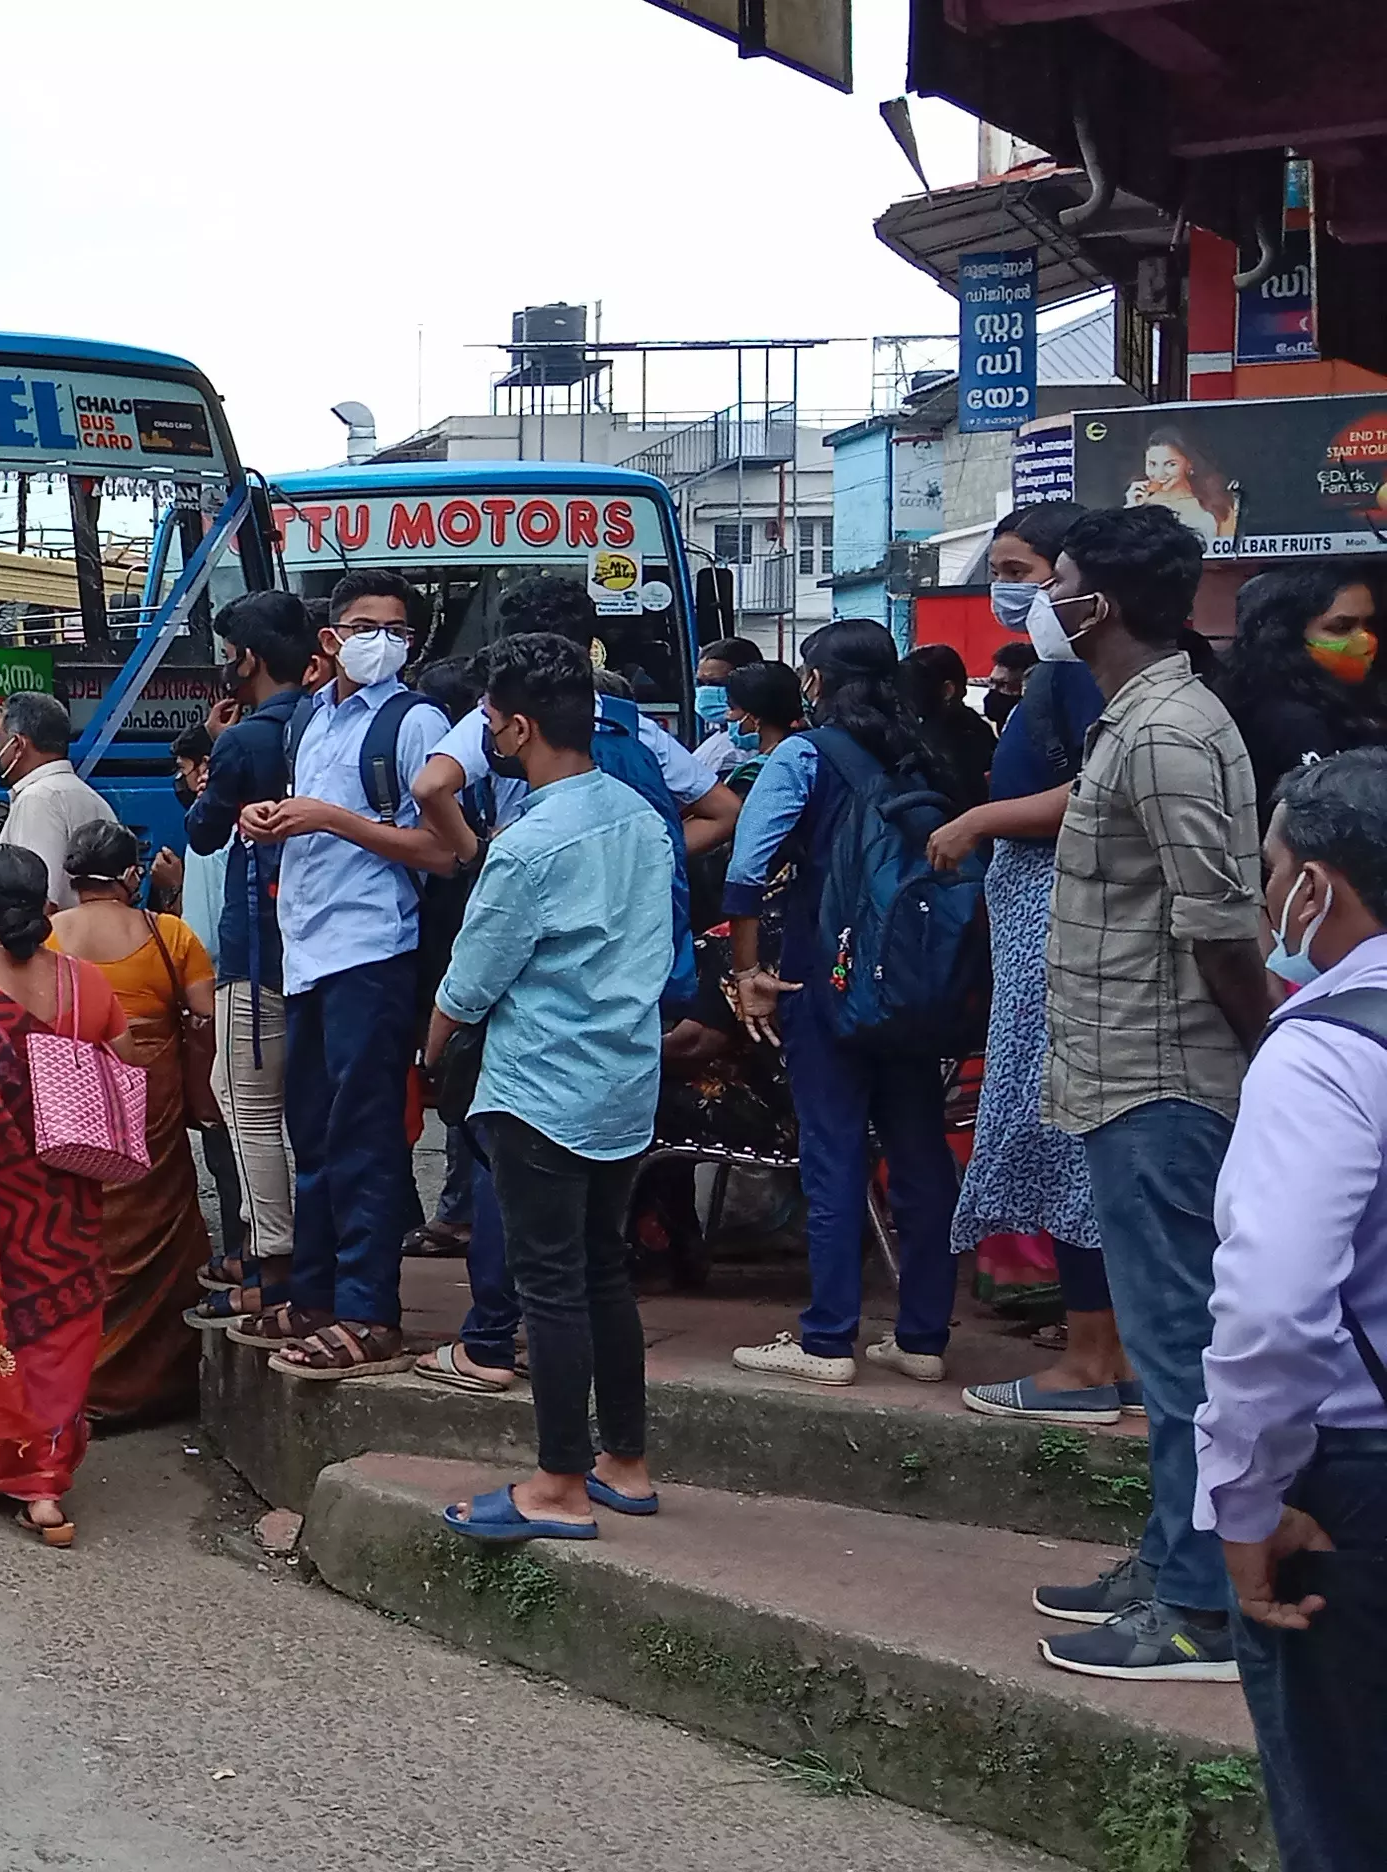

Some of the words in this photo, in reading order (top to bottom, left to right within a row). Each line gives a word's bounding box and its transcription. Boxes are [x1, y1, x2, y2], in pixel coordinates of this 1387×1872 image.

[976, 346, 1023, 376] ഡി
[76, 396, 133, 414] CHALO
[967, 387, 1029, 410] യോ
[79, 414, 115, 431] BUS
[83, 433, 133, 450] CARD
[1349, 431, 1373, 442] END
[1327, 446, 1358, 458] START
[228, 504, 370, 554] TTU
[387, 499, 635, 549] MOTORS
[1281, 537, 1331, 552] FRUITS
